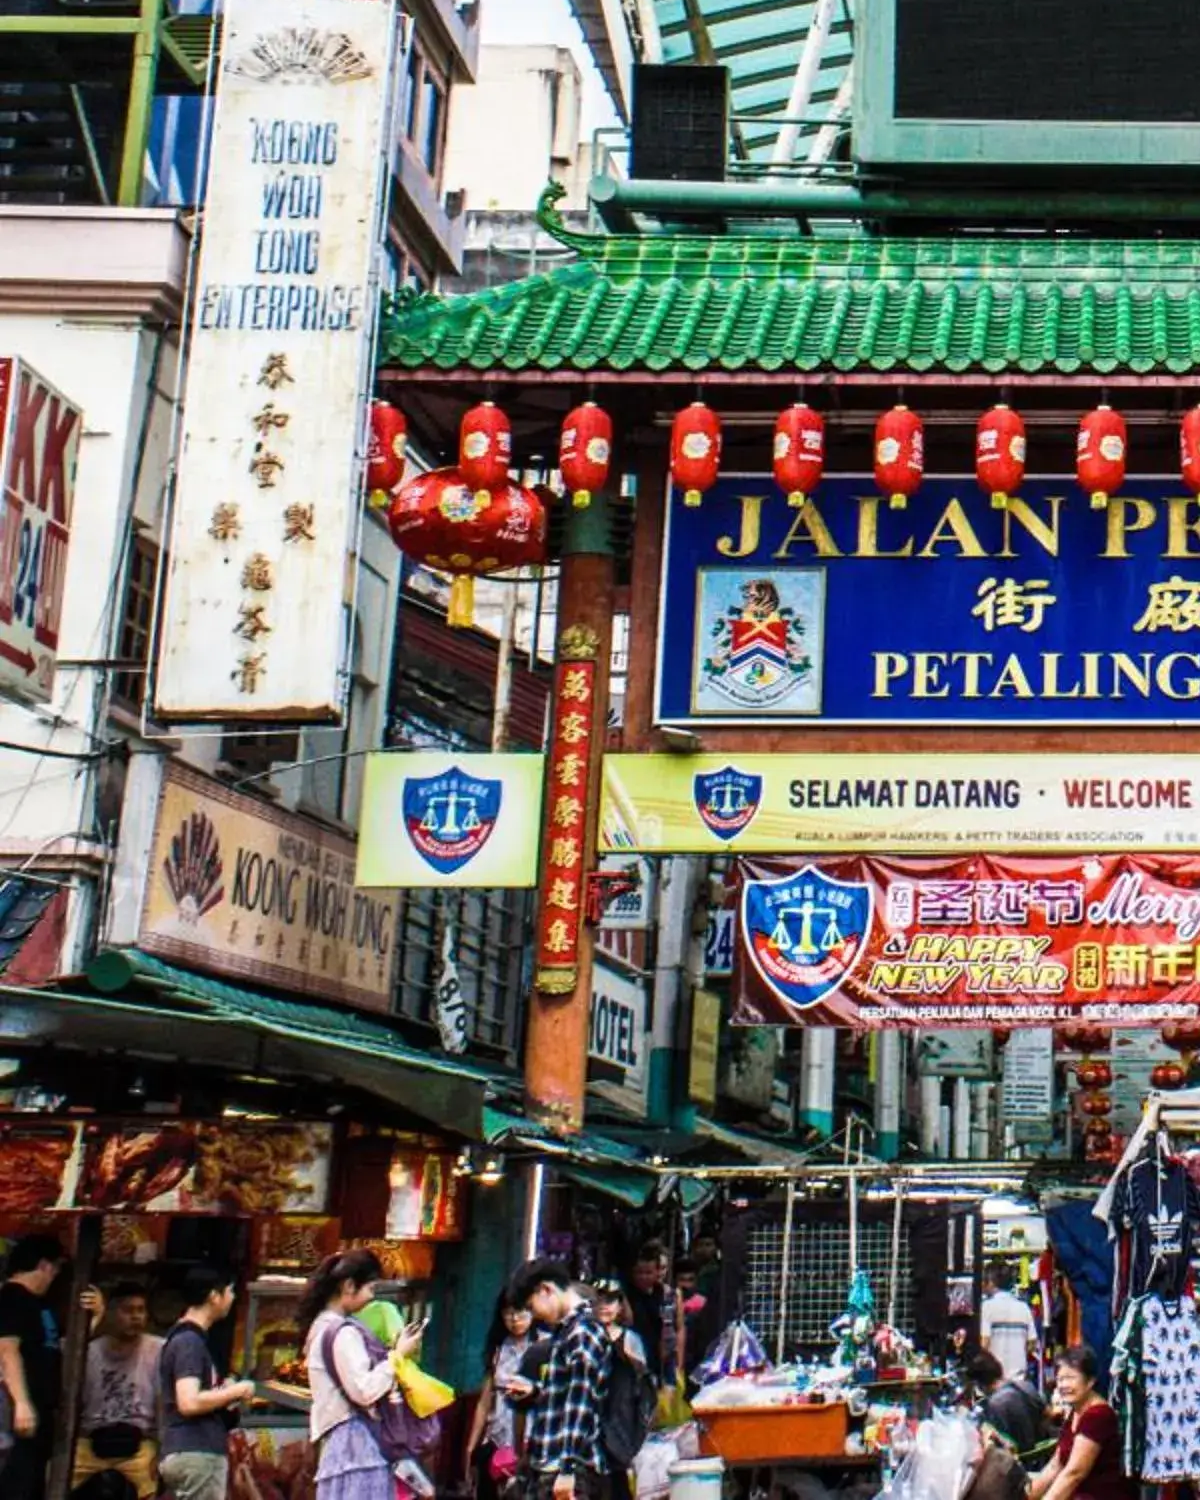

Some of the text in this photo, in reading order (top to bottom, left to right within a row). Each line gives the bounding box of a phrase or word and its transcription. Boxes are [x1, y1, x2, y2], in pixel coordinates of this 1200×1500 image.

[263, 174, 323, 219] WOH
[200, 284, 363, 331] ENTERPRISE
[715, 495, 1066, 559] JALAN
[788, 779, 906, 809] SELAMAT
[918, 779, 1021, 809] DATANG
[1064, 779, 1193, 809] WELCOME
[1065, 831, 1145, 843] ASSOCIATION
[231, 847, 300, 925] KOONG
[918, 880, 1084, 924] 圣诞节
[908, 934, 1051, 964] HAPPY
[869, 964, 1068, 993] NEW YEAR
